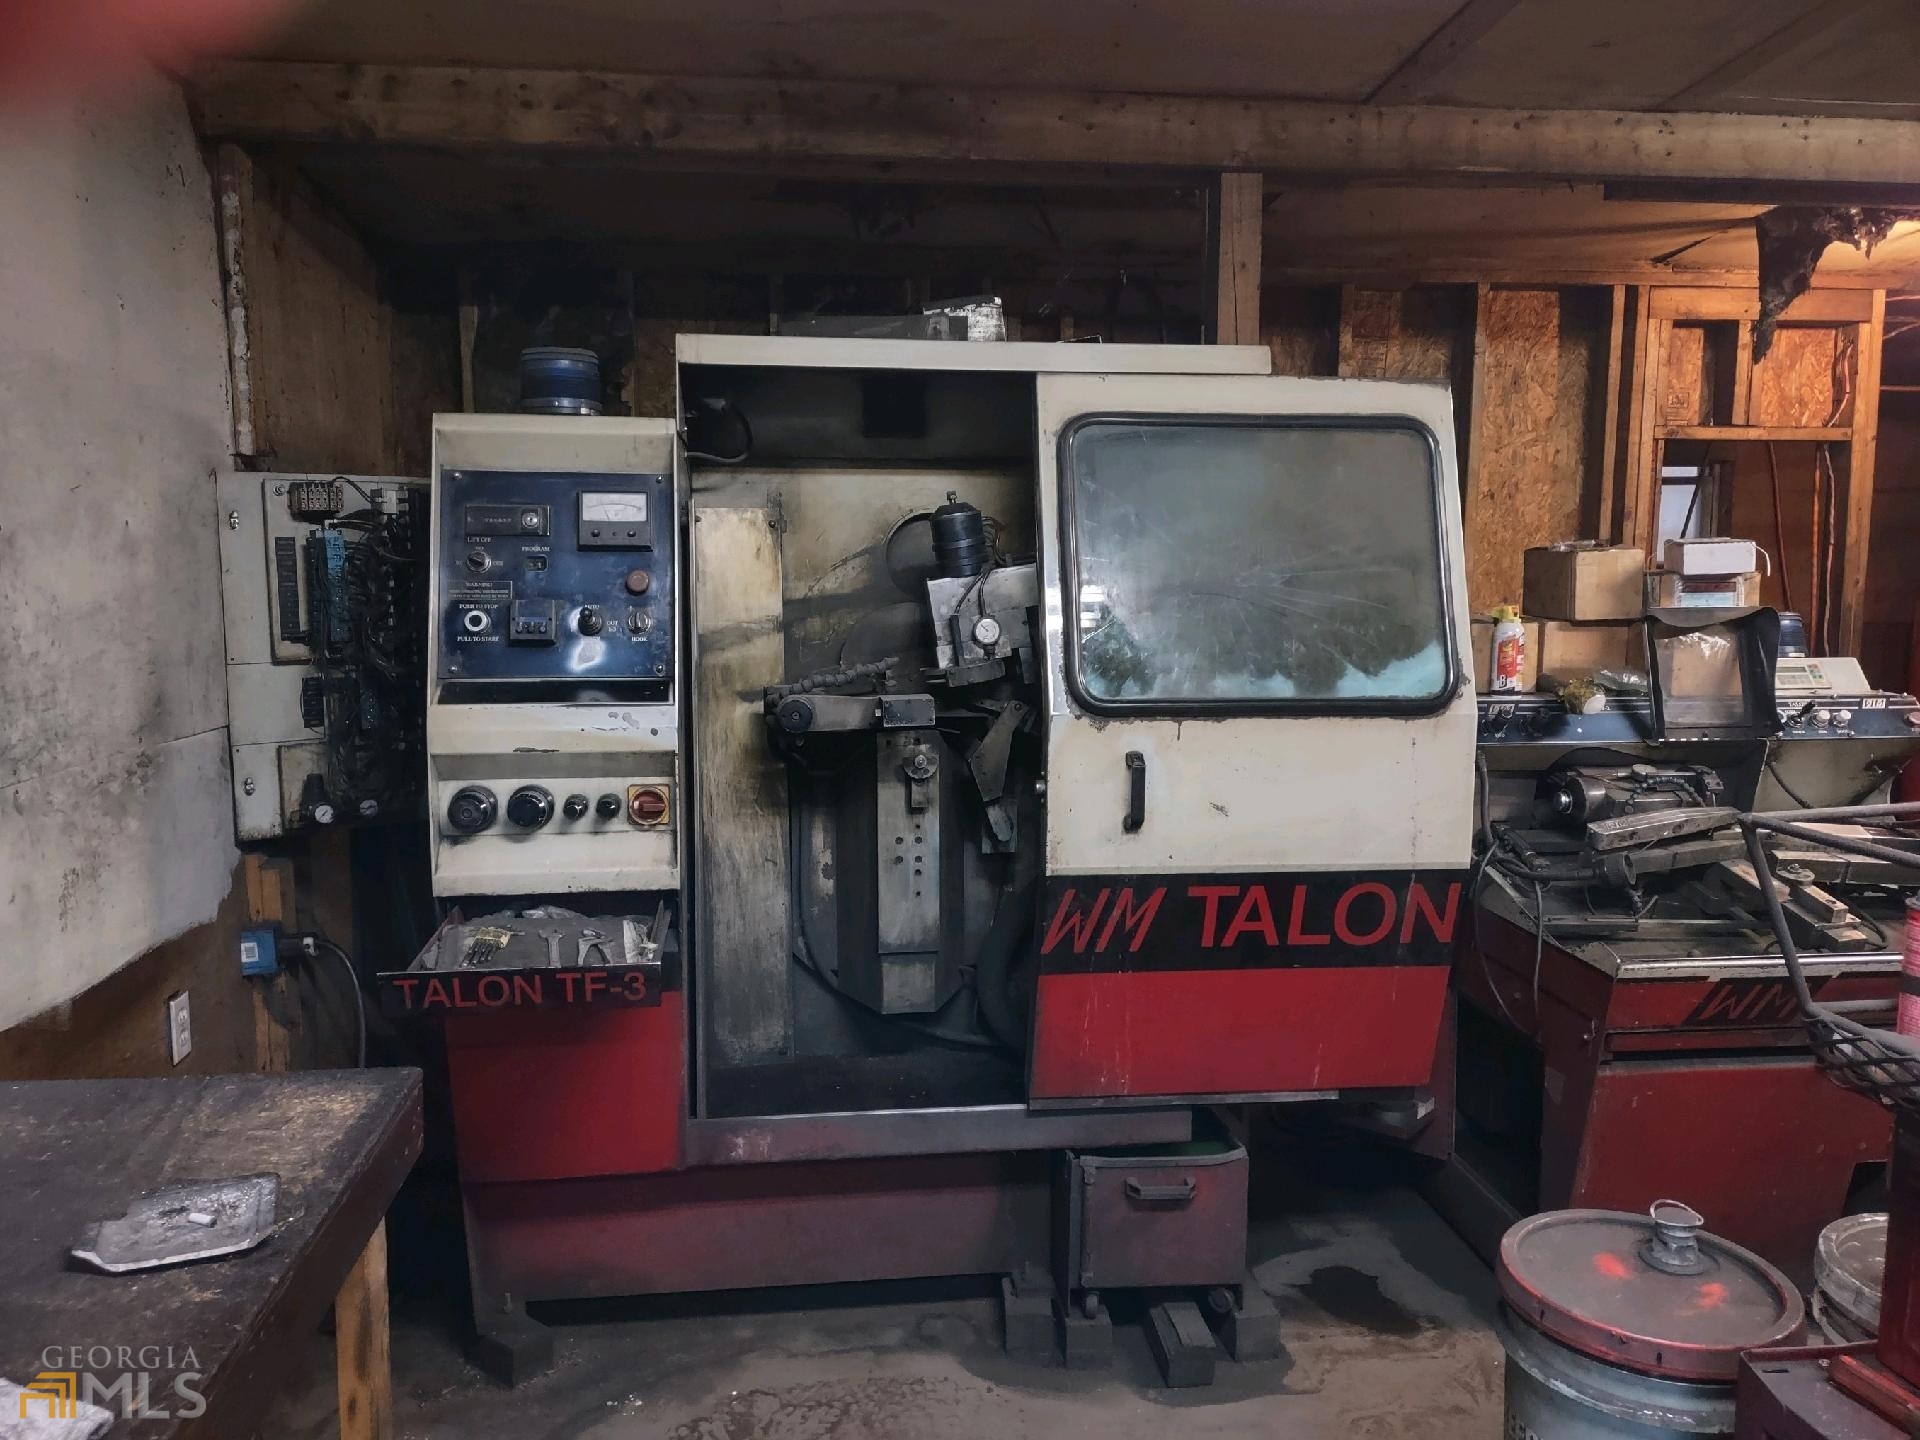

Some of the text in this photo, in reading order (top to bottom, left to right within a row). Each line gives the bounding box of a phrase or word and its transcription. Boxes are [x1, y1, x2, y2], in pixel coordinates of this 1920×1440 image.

[1041, 882, 1461, 954] WM TALON
[392, 971, 647, 1010] TALON TF-3
[1700, 983, 1797, 1020] WM
